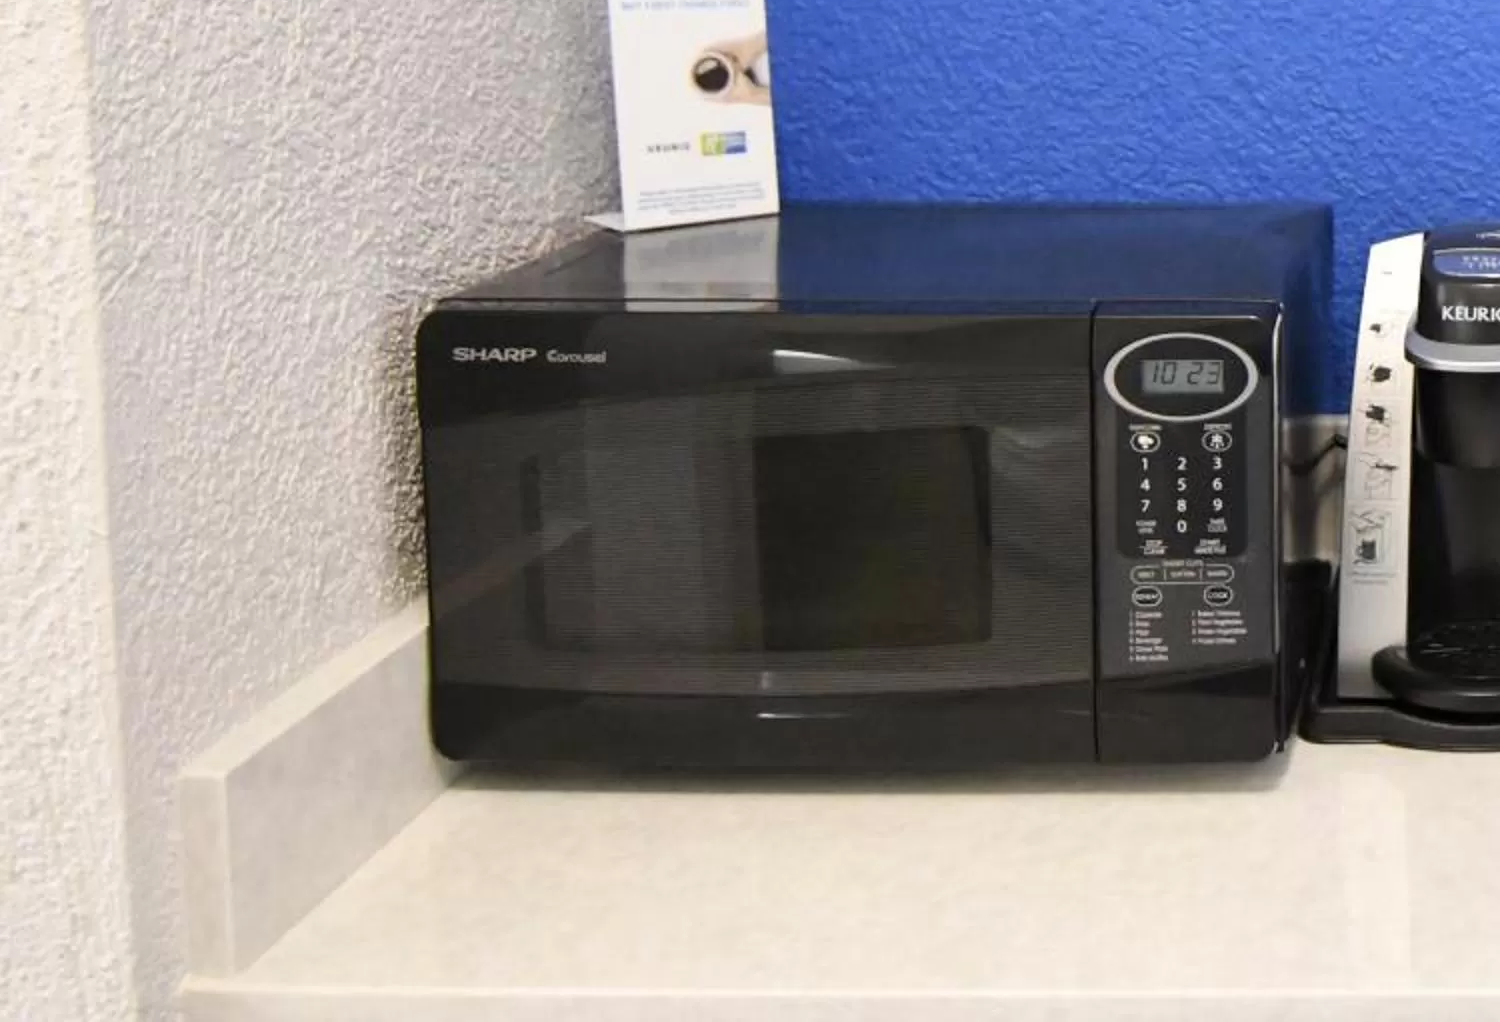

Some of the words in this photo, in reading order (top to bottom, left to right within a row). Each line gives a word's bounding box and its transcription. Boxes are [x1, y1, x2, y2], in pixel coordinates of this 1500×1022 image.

[452, 347, 538, 362] SHARP
[546, 349, 608, 363] Carousel
[1141, 457, 1149, 471] 1
[1177, 457, 1187, 471] 2
[1213, 457, 1222, 470] 3
[1140, 478, 1150, 491] 4
[1177, 478, 1187, 491] 5
[1213, 478, 1223, 491] 6
[1141, 499, 1151, 512] 7
[1177, 499, 1187, 512] 8
[1213, 498, 1223, 511] 9
[1177, 519, 1187, 533] 0
